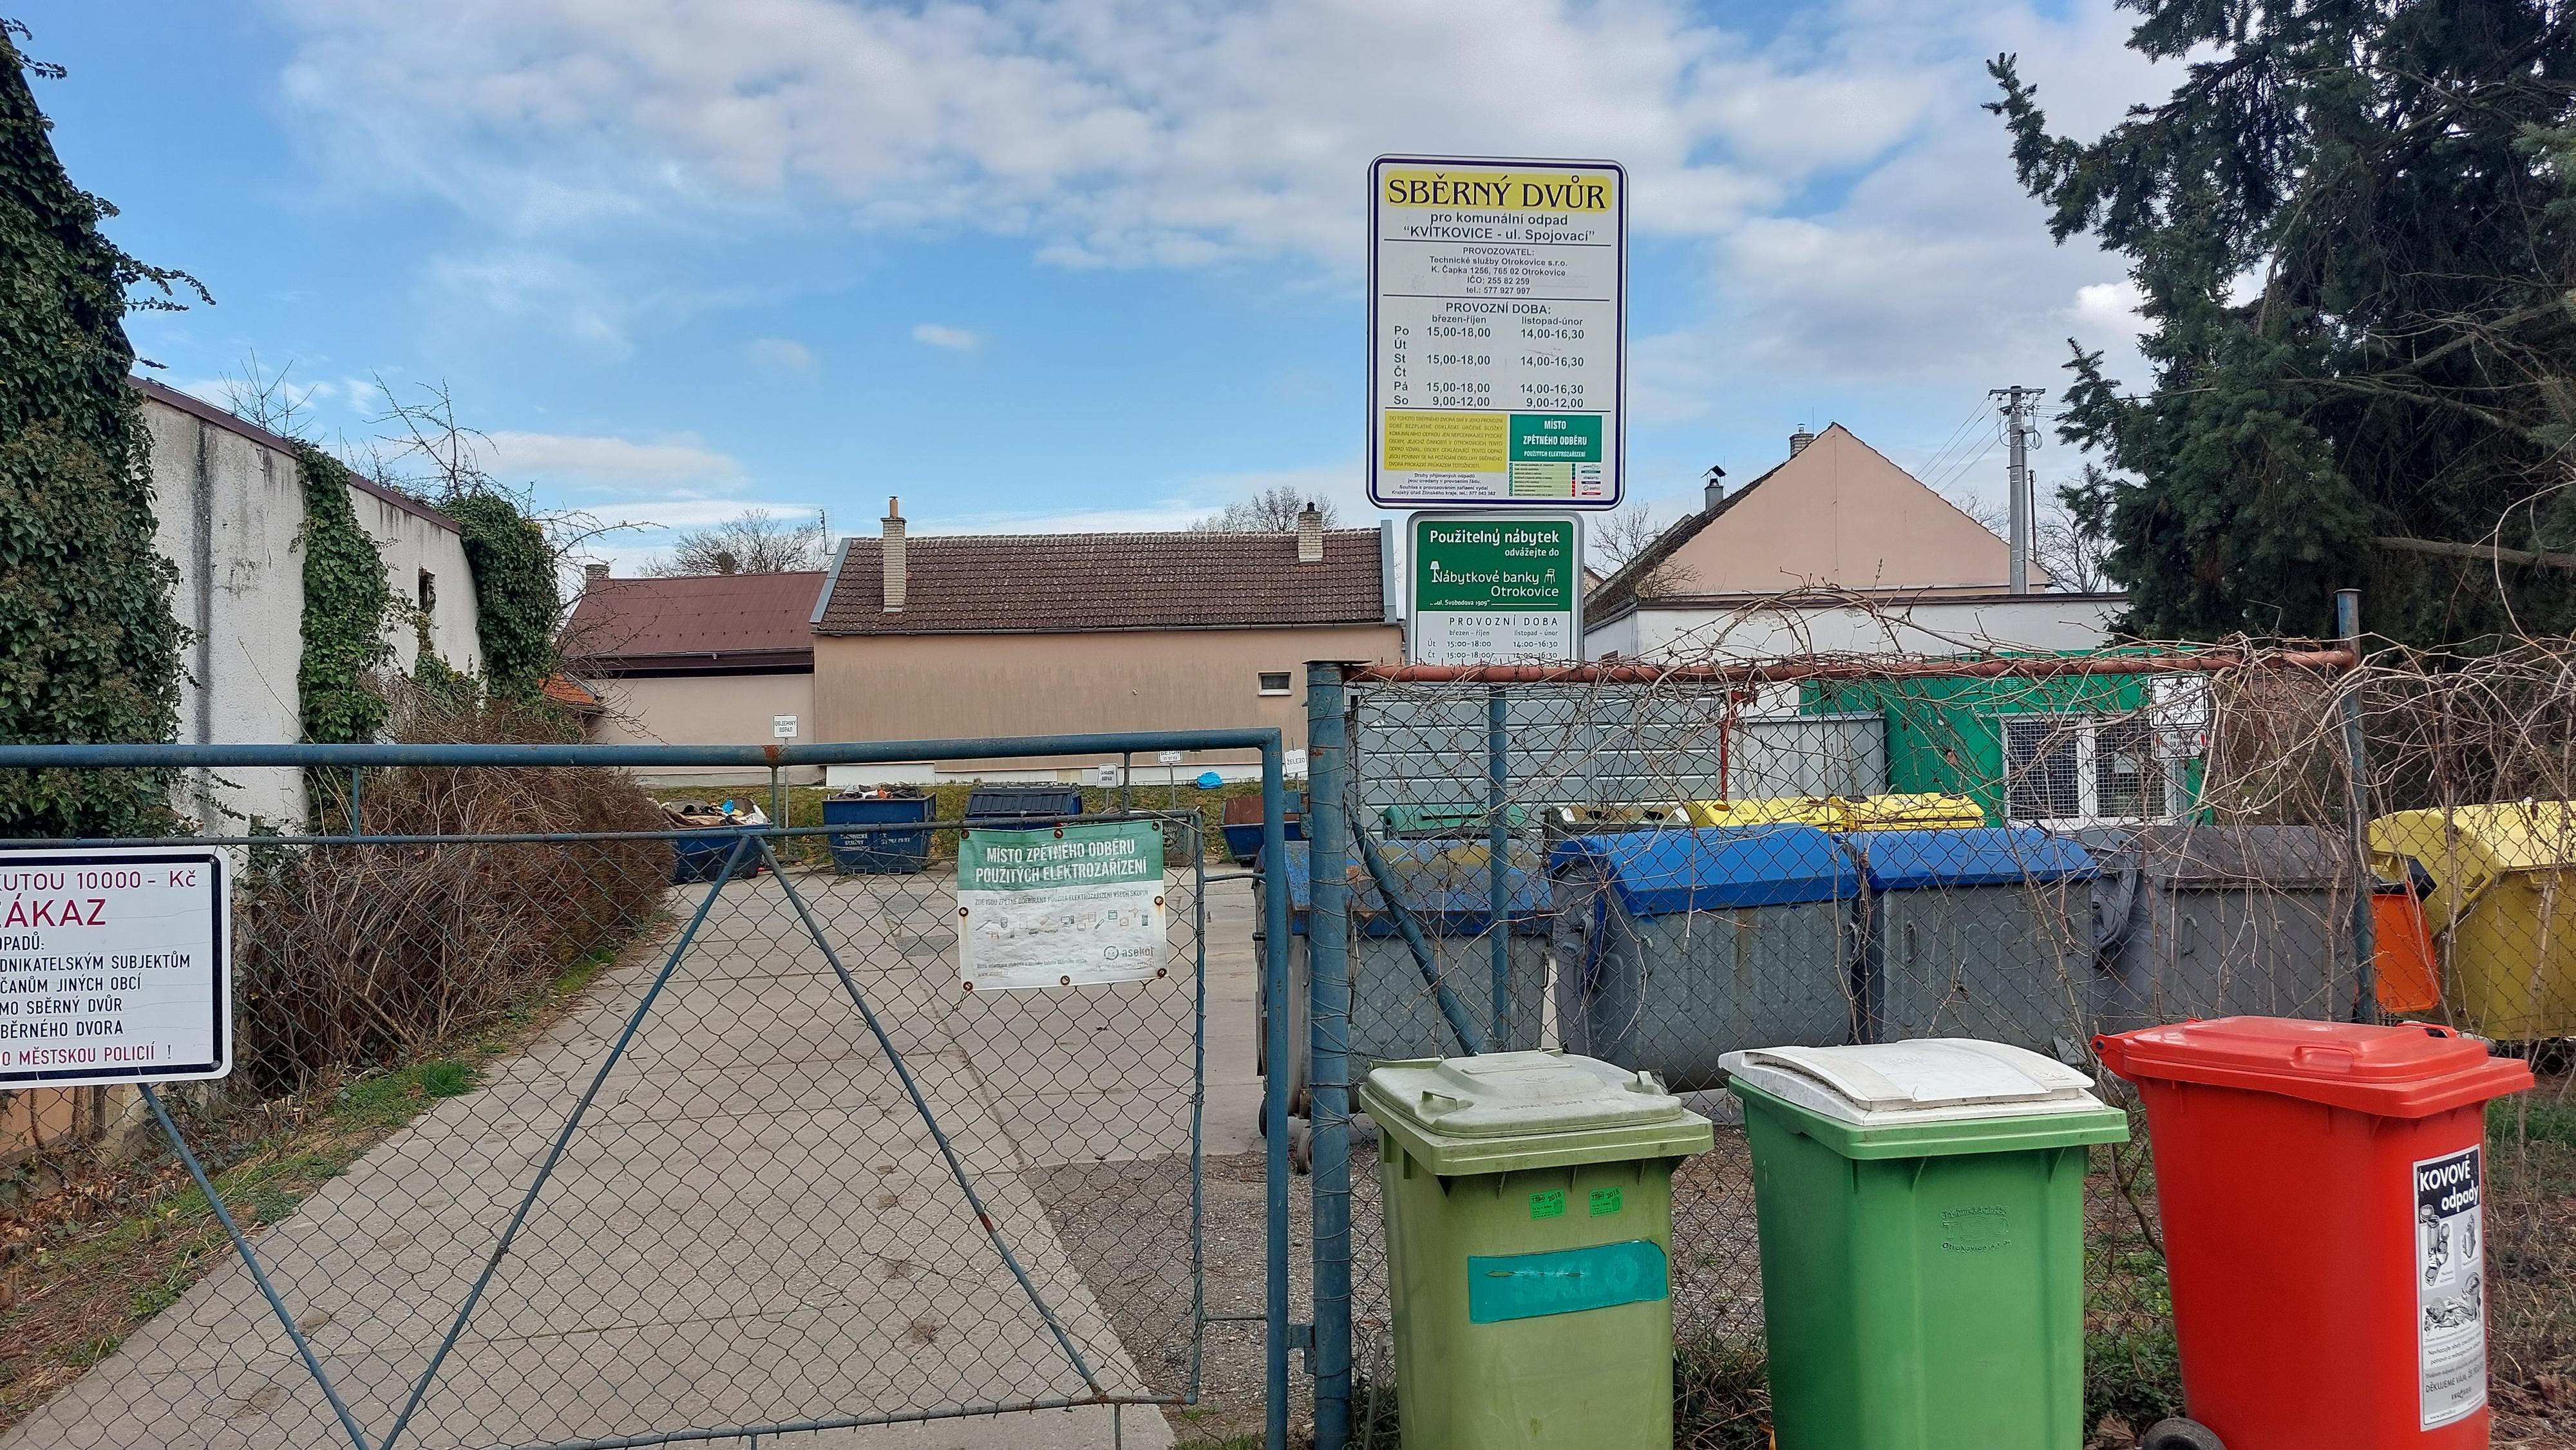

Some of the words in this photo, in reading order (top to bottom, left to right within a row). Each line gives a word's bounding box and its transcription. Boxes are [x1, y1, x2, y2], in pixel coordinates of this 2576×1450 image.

[1388, 173, 1512, 207] SBĚRNÝ
[1522, 175, 1606, 209] DVŮR
[1430, 212, 1452, 225] pro
[1456, 212, 1524, 225] komunální
[1528, 215, 1568, 228] odpad
[1506, 229, 1520, 240] ul.
[1463, 247, 1535, 256] PROVOZOVATEL:
[1429, 256, 1470, 264] Technické
[1473, 257, 1499, 267] služby
[1501, 258, 1546, 266] Otrokovice
[1442, 265, 1468, 275] Čapka
[1522, 267, 1566, 276] Otrokovice
[1467, 276, 1485, 284] IČO:
[1445, 301, 1509, 314] PROVOZNÍ
[1512, 304, 1551, 314] DOBA:
[1432, 314, 1486, 325] březen-říjen
[1521, 315, 1584, 326] listopad-únor
[1394, 326, 1409, 335] Po
[1426, 326, 1491, 339] 15,00-18,00
[1520, 328, 1584, 341] 14,00-16,30
[1394, 337, 1407, 349] Út
[1394, 353, 1406, 363] St
[1426, 355, 1490, 366] 15,00-18,00
[1520, 356, 1584, 368] 14,00-16,30
[1394, 365, 1407, 377] Čt
[1394, 381, 1408, 391] Pá
[1426, 382, 1490, 394] 15,00-18,00
[1520, 384, 1584, 395] 14,00-16,30
[1394, 395, 1409, 405] So
[1432, 397, 1490, 408] 9,00-12,00
[1526, 398, 1584, 410] 9,00-12,00
[1544, 419, 1567, 430] MÍSTO
[1522, 434, 1558, 445] ZPĚTNÉHO
[1559, 435, 1587, 446] ODBĚRU
[1430, 528, 1500, 546] Použitelný
[1504, 528, 1560, 546] nábytek
[1504, 547, 1546, 558] odvážejte
[1549, 547, 1559, 556] do
[1433, 569, 1499, 585] Nábytkové
[1503, 571, 1539, 585] banky
[1491, 585, 1559, 597] Otrokovice
[1449, 614, 1516, 626] PROVOZNÍ
[1524, 617, 1558, 626] DOBA
[1427, 637, 1436, 647] Út
[986, 844, 1023, 863] MÍSTO
[1026, 842, 1085, 862] ZPĚTNÉHO
[1088, 838, 1135, 857] ODBĚRU
[975, 865, 1039, 883] POUŽITÝCH
[1043, 856, 1147, 881] ELEKTROZAŘÍZENÍ
[0, 872, 64, 891] UTOU
[169, 869, 196, 888] Kč
[0, 892, 106, 928] ÁKAZ
[0, 931, 45, 951] PADŮ:
[1122, 946, 1153, 957] asekol
[111, 950, 191, 970] SUBJEKTŮM
[1, 975, 48, 994] ČANŮM
[56, 972, 103, 992] JINÝCH
[111, 972, 142, 990] OBCÍ
[26, 996, 80, 1015] SBĚRNÝ
[88, 994, 122, 1012] DVŮR
[1, 1019, 68, 1039] BĚRNÉHO
[77, 1020, 124, 1036] DVORA
[19, 1046, 96, 1066] MĚSTSKOU
[104, 1040, 155, 1062] POLICIÍ
[167, 1044, 171, 1060] !
[2420, 1154, 2471, 1192] KOVOVÉ
[1547, 1191, 1562, 1202] 2018
[2441, 1180, 2479, 1212] odpady
